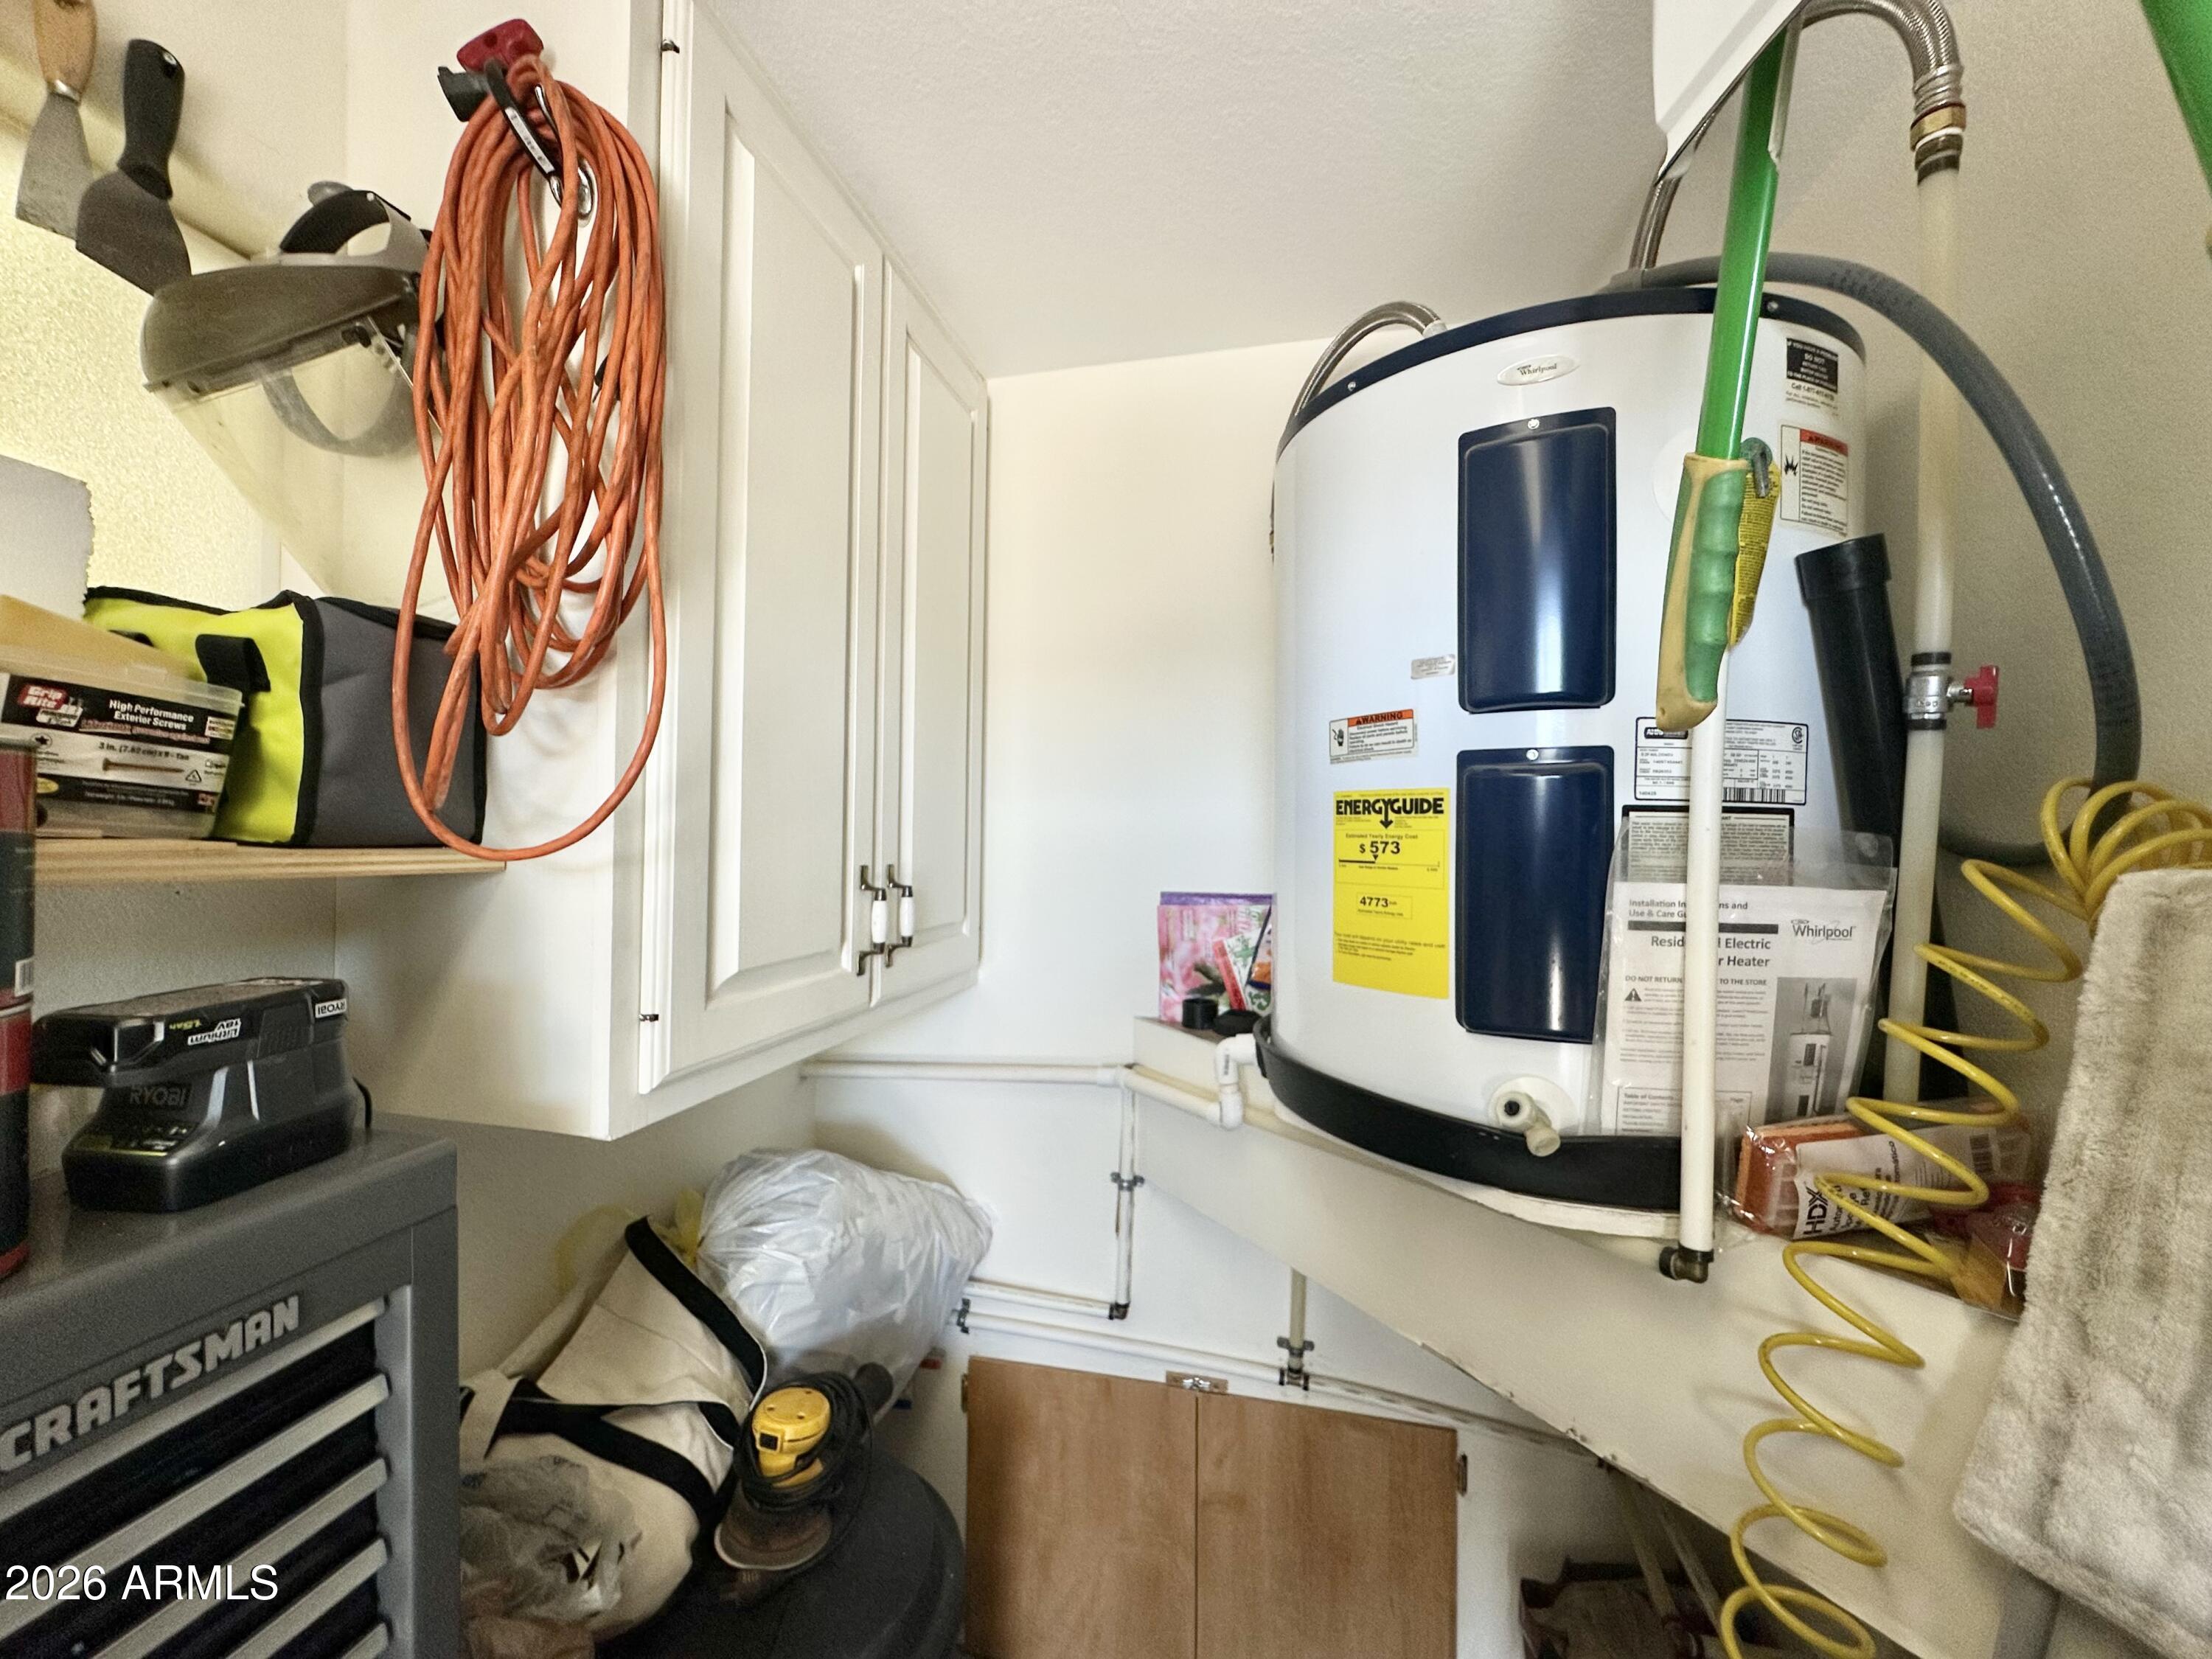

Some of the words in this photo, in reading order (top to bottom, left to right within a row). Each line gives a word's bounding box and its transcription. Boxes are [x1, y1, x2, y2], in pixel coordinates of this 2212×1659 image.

[1519, 364, 1557, 375] Whirlpool
[29, 686, 63, 700] Grip
[109, 699, 133, 712] High
[134, 703, 194, 723] Performance
[1362, 712, 1403, 723] WARNING
[114, 711, 151, 726] Exterior
[153, 717, 187, 731] Screws
[1336, 797, 1444, 815] ENERGYGUIDE
[1359, 844, 1366, 854] $
[1370, 841, 1400, 854] 573
[1360, 897, 1388, 908] 4773
[1629, 899, 1676, 908] Installation
[1732, 902, 1748, 910] and
[1656, 910, 1675, 918] Care
[1792, 925, 1853, 941] Whirlpool
[1725, 938, 1771, 950] Electric
[1727, 956, 1770, 967] Heater
[318, 1000, 346, 1015] RYOBI
[129, 1084, 189, 1106] RYOBI
[1803, 1186, 1829, 1234] HDX
[0, 1295, 300, 1472] CRAFTSMAN
